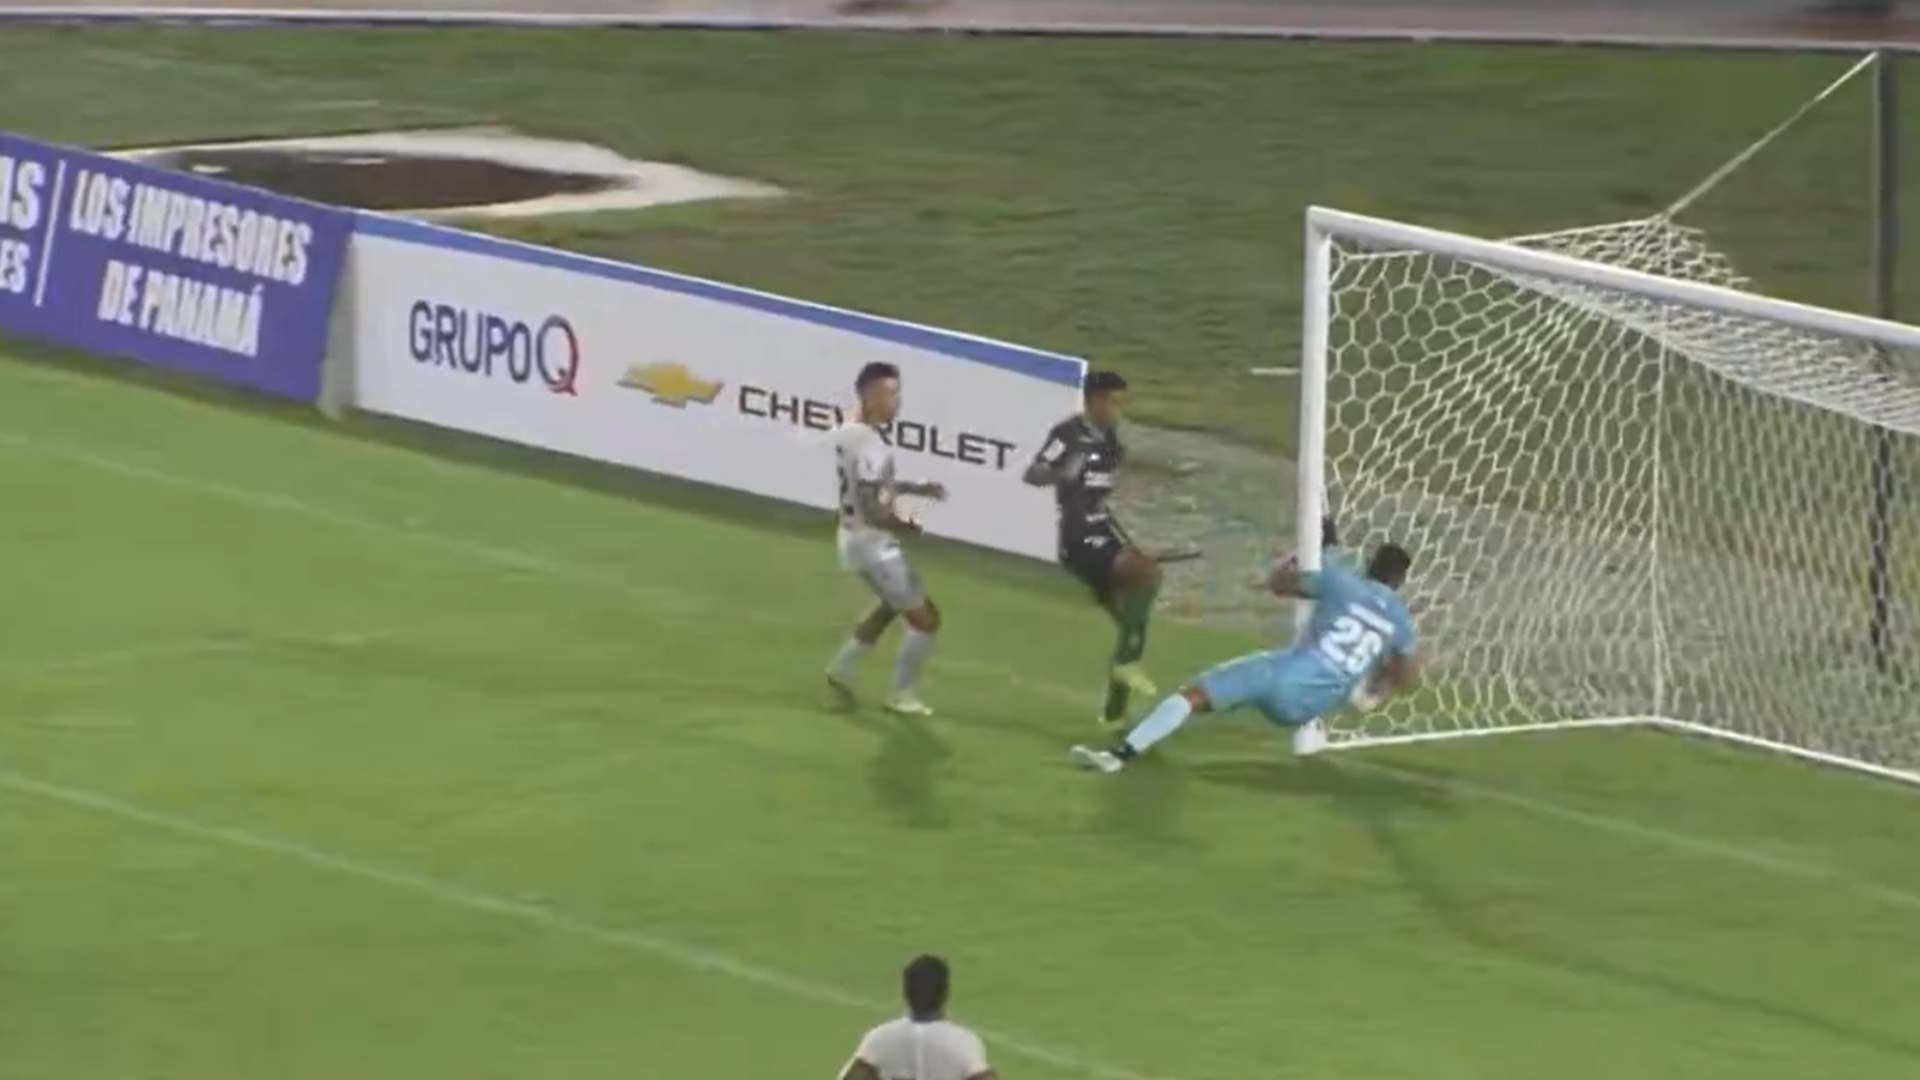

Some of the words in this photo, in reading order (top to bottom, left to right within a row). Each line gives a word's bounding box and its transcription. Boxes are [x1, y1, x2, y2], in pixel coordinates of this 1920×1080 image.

[69, 169, 131, 240] LOS
[126, 182, 313, 286] IMPRESORES
[97, 259, 142, 325] DE
[139, 268, 264, 358] PANAMÁ
[1319, 615, 1383, 675] 26
